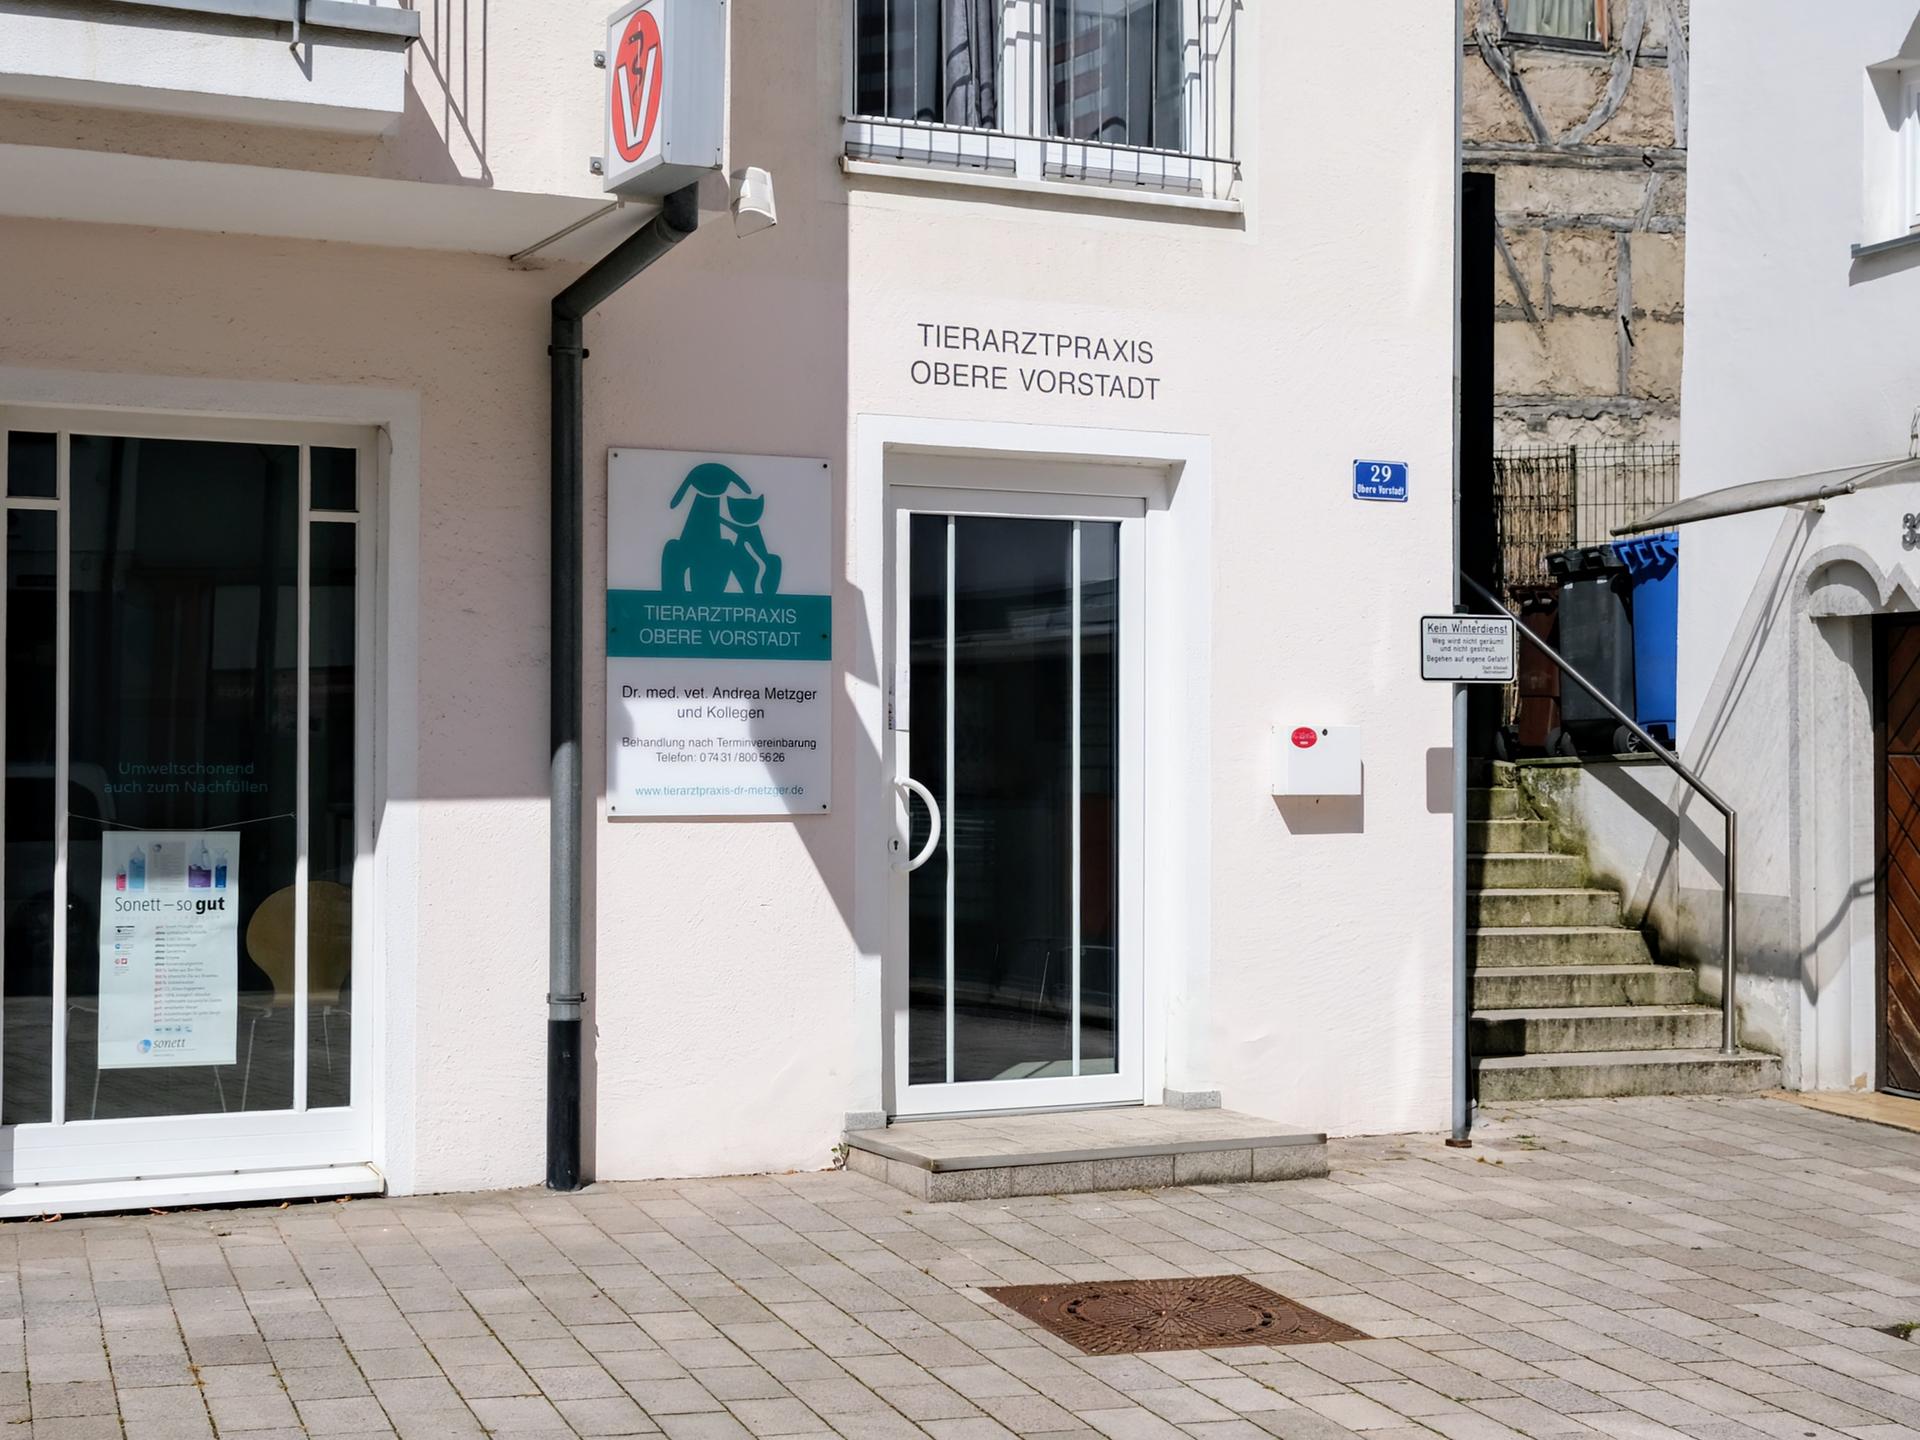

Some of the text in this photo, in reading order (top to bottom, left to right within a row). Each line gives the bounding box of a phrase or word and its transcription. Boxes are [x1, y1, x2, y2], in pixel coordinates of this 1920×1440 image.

[917, 322, 1154, 365] TIERARZTPRAXIS
[911, 360, 1161, 400] OBERE VORSTADT
[1371, 465, 1392, 483] 29
[1357, 483, 1404, 495] Obere Vorstadt
[643, 604, 798, 624] TIERARZTPRAXIS
[1427, 622, 1508, 634] Kein Winterdienst
[639, 627, 801, 648] OBERE VORSTADT
[1426, 654, 1453, 664] Begehen
[1466, 655, 1486, 664] eigene
[622, 685, 817, 703] Dr. med. vet. Andrea Metzger
[677, 706, 765, 721] und Kollegen
[622, 737, 817, 750] Behandlung nach Terminvereinbarung
[656, 752, 697, 763] Telefon:
[118, 761, 255, 776] Umweltschonend
[103, 780, 269, 793] auch zum Nachfüllen
[635, 785, 805, 799] www.tierarztpraxis-dr-metzger.de
[114, 896, 161, 912] Sonett
[176, 899, 193, 912] so
[195, 896, 225, 915] gut
